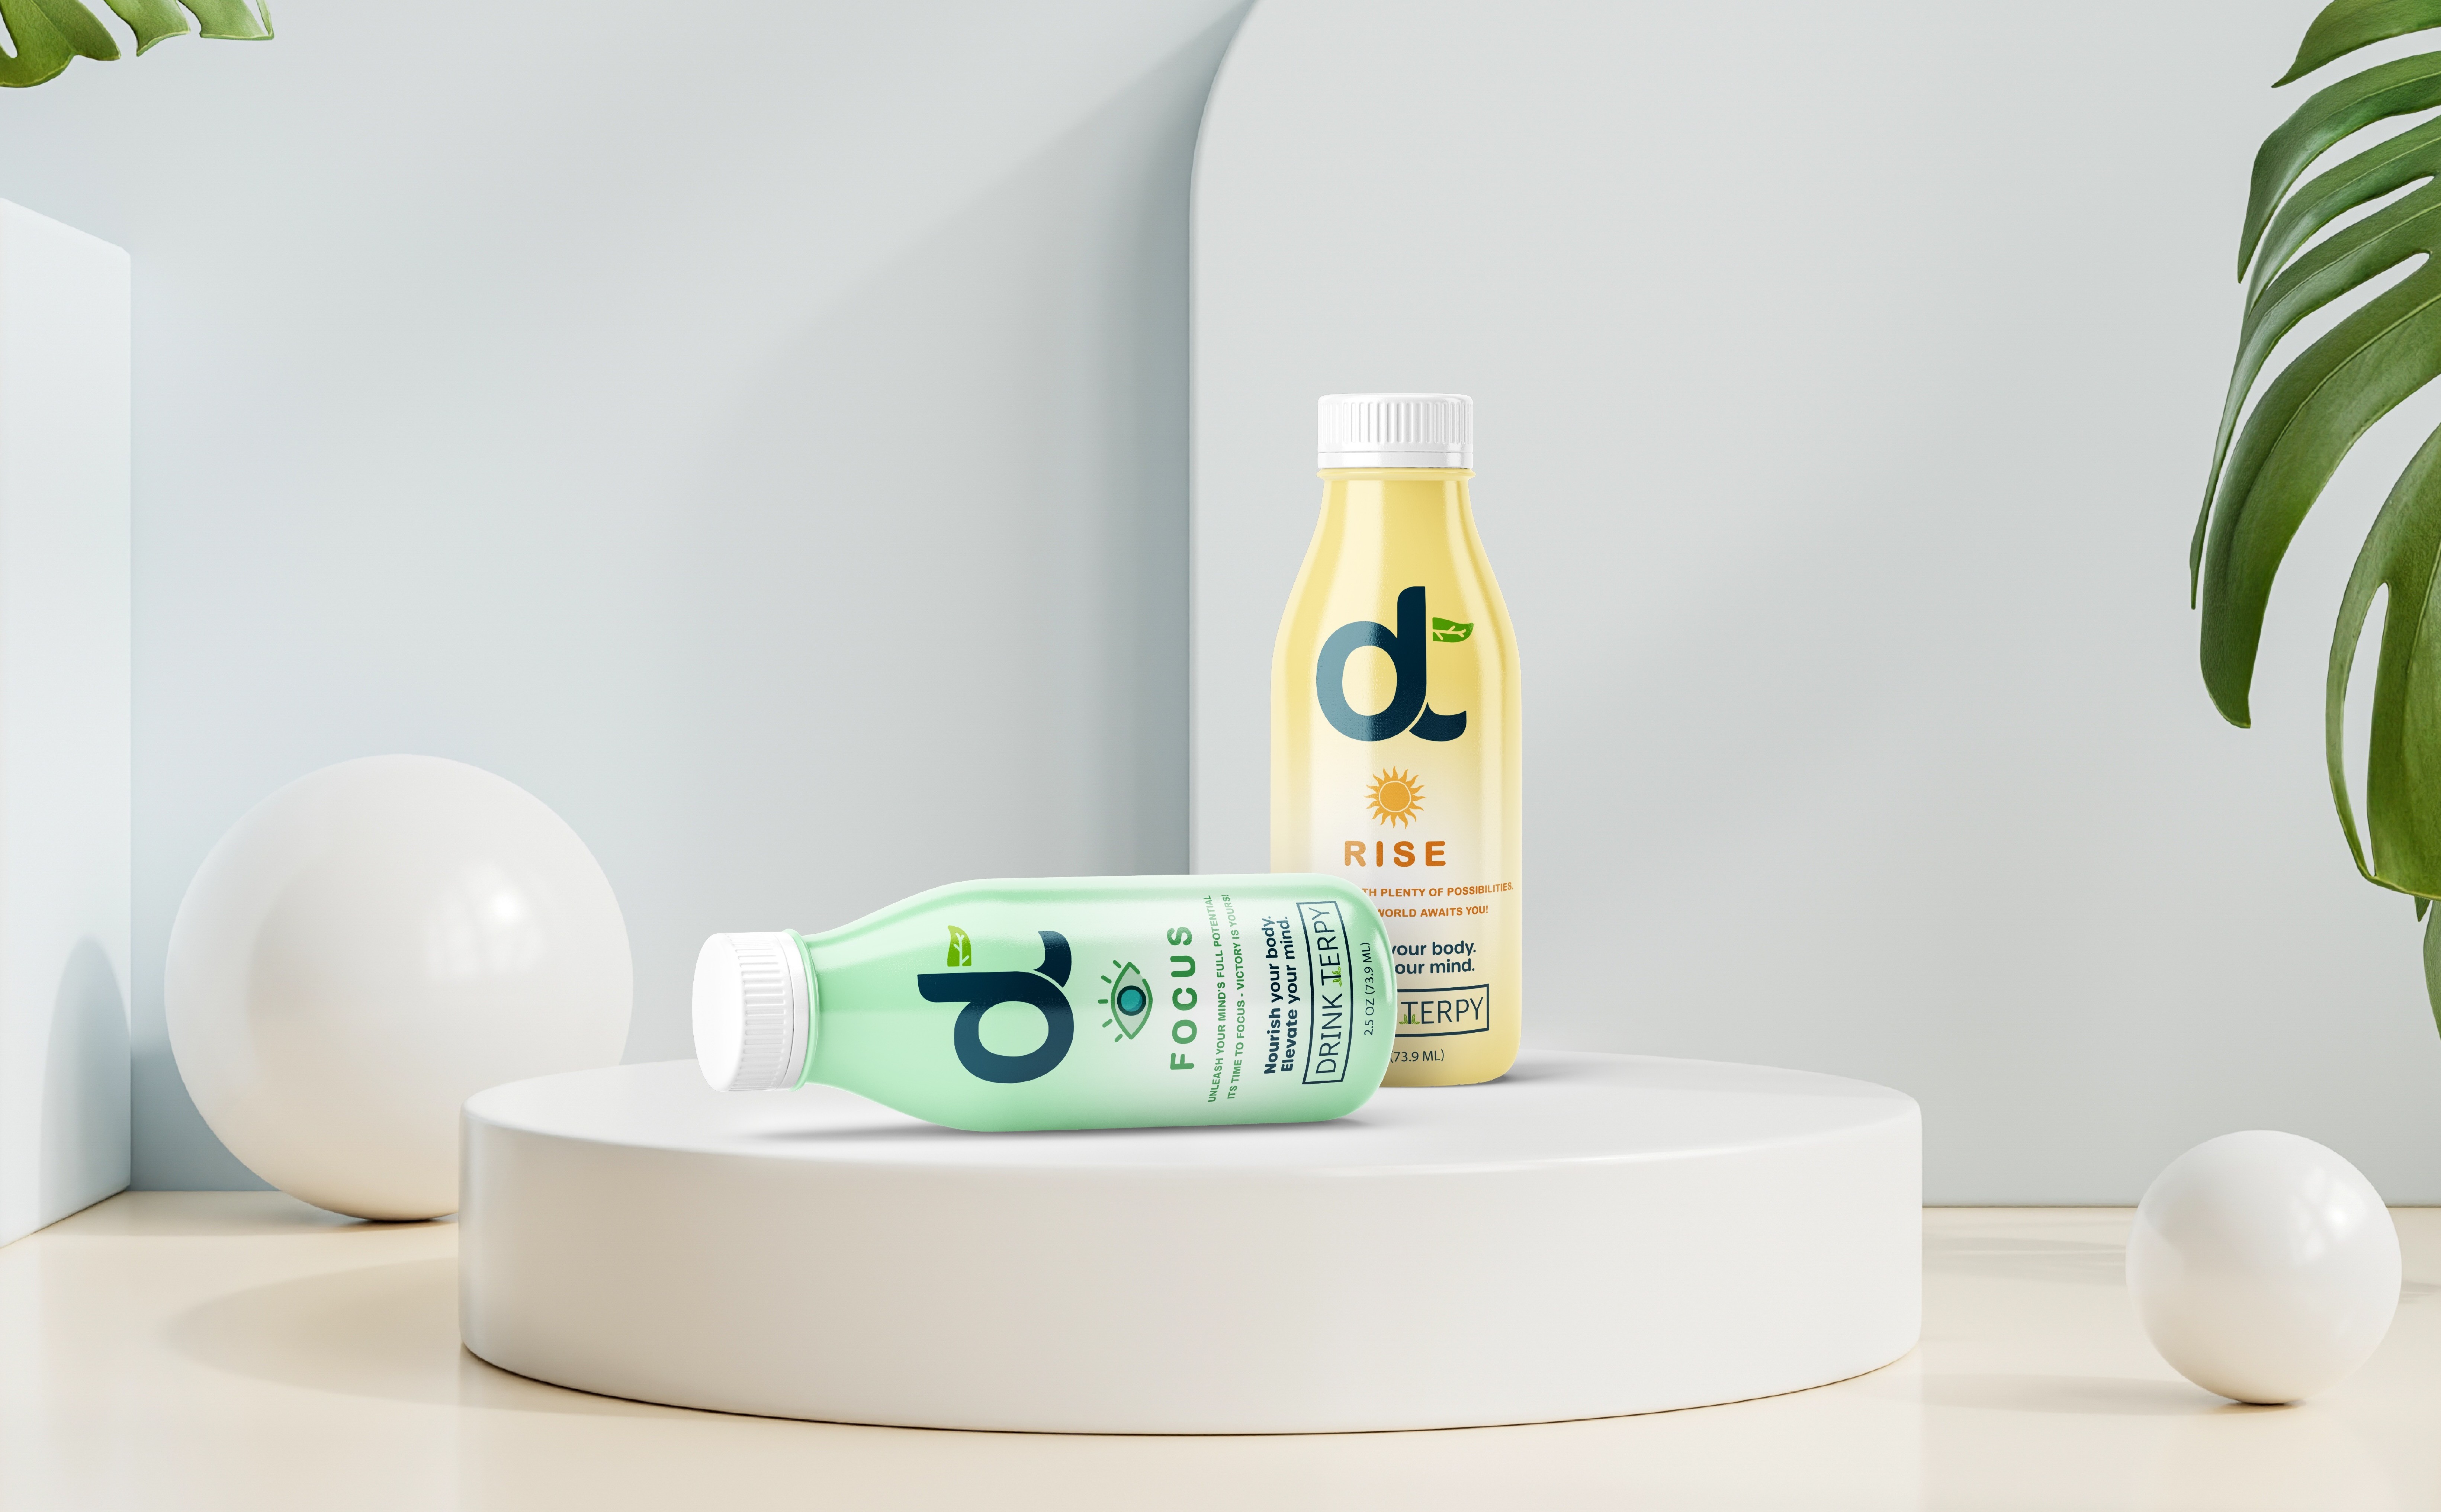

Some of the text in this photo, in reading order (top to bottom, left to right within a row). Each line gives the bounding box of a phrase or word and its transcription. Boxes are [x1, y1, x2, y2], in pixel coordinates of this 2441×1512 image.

[1345, 840, 1446, 867] RISE
[1381, 888, 1426, 897] PLENTY
[1429, 888, 1443, 897] OF
[1447, 882, 1513, 896] POSSIBILITIES.
[1221, 894, 1237, 927] YOURS!
[1420, 907, 1462, 917] AWAITS
[1465, 905, 1488, 915] YOU!
[1231, 929, 1240, 939] IS
[1432, 940, 1476, 956] body.
[1233, 942, 1244, 990] VICTORY
[1430, 958, 1475, 974] mind.
[1167, 926, 1197, 1070] FOCUS
[1203, 895, 1226, 1102] UNLEASH YOUR MIND'S FULL POTENTIAL
[1261, 916, 1283, 1074] Nourish your body.
[1276, 916, 1300, 1072] Elevate your mind.
[1308, 907, 1343, 1074] DRINK TERPY
[1359, 942, 1376, 1036] 2.5 OZ (73.9 ML)
[1237, 1000, 1245, 1039] FOCUS
[1399, 997, 1483, 1024] TERPY
[1235, 1042, 1244, 1056] TO
[1423, 1049, 1444, 1062] ML)
[1231, 1059, 1242, 1084] TIME
[1227, 1085, 1237, 1099] ITS
